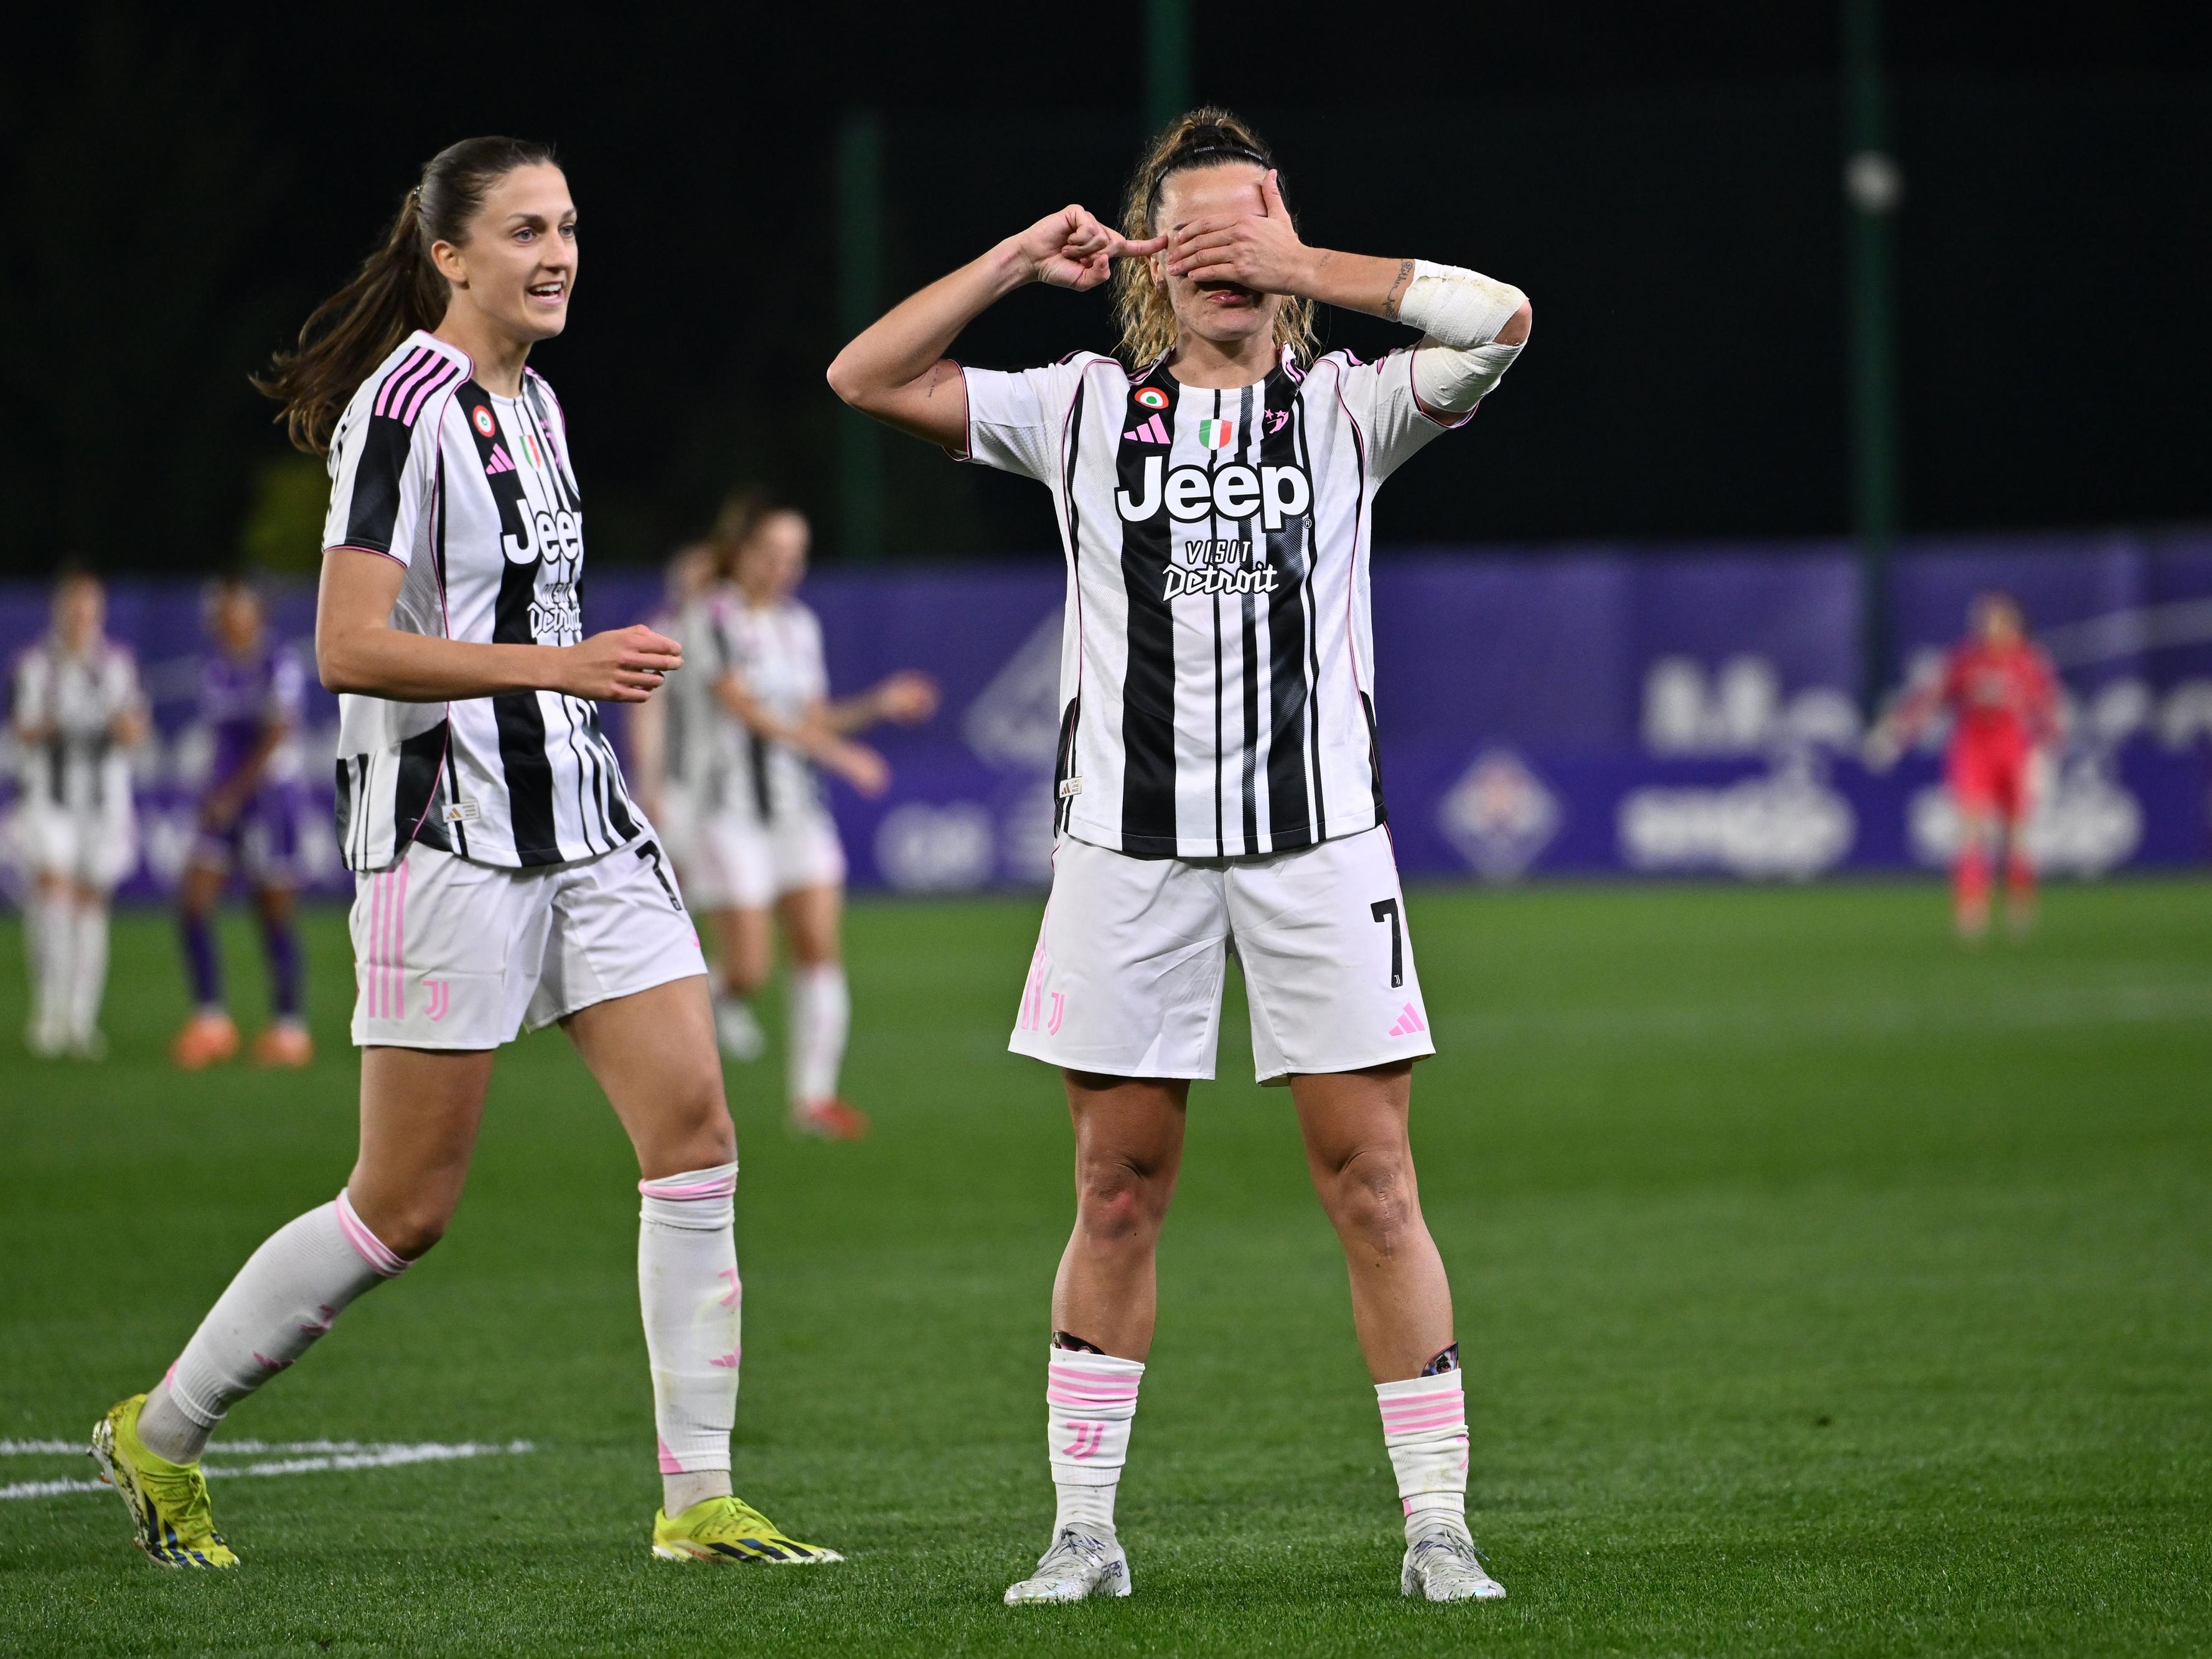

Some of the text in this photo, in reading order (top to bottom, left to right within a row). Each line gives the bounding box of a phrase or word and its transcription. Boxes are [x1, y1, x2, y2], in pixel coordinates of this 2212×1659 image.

[1117, 456, 1310, 530] Jeep
[1186, 540, 1251, 563] VISIT
[1162, 563, 1279, 601] Detroit
[1370, 897, 1404, 989] 7
